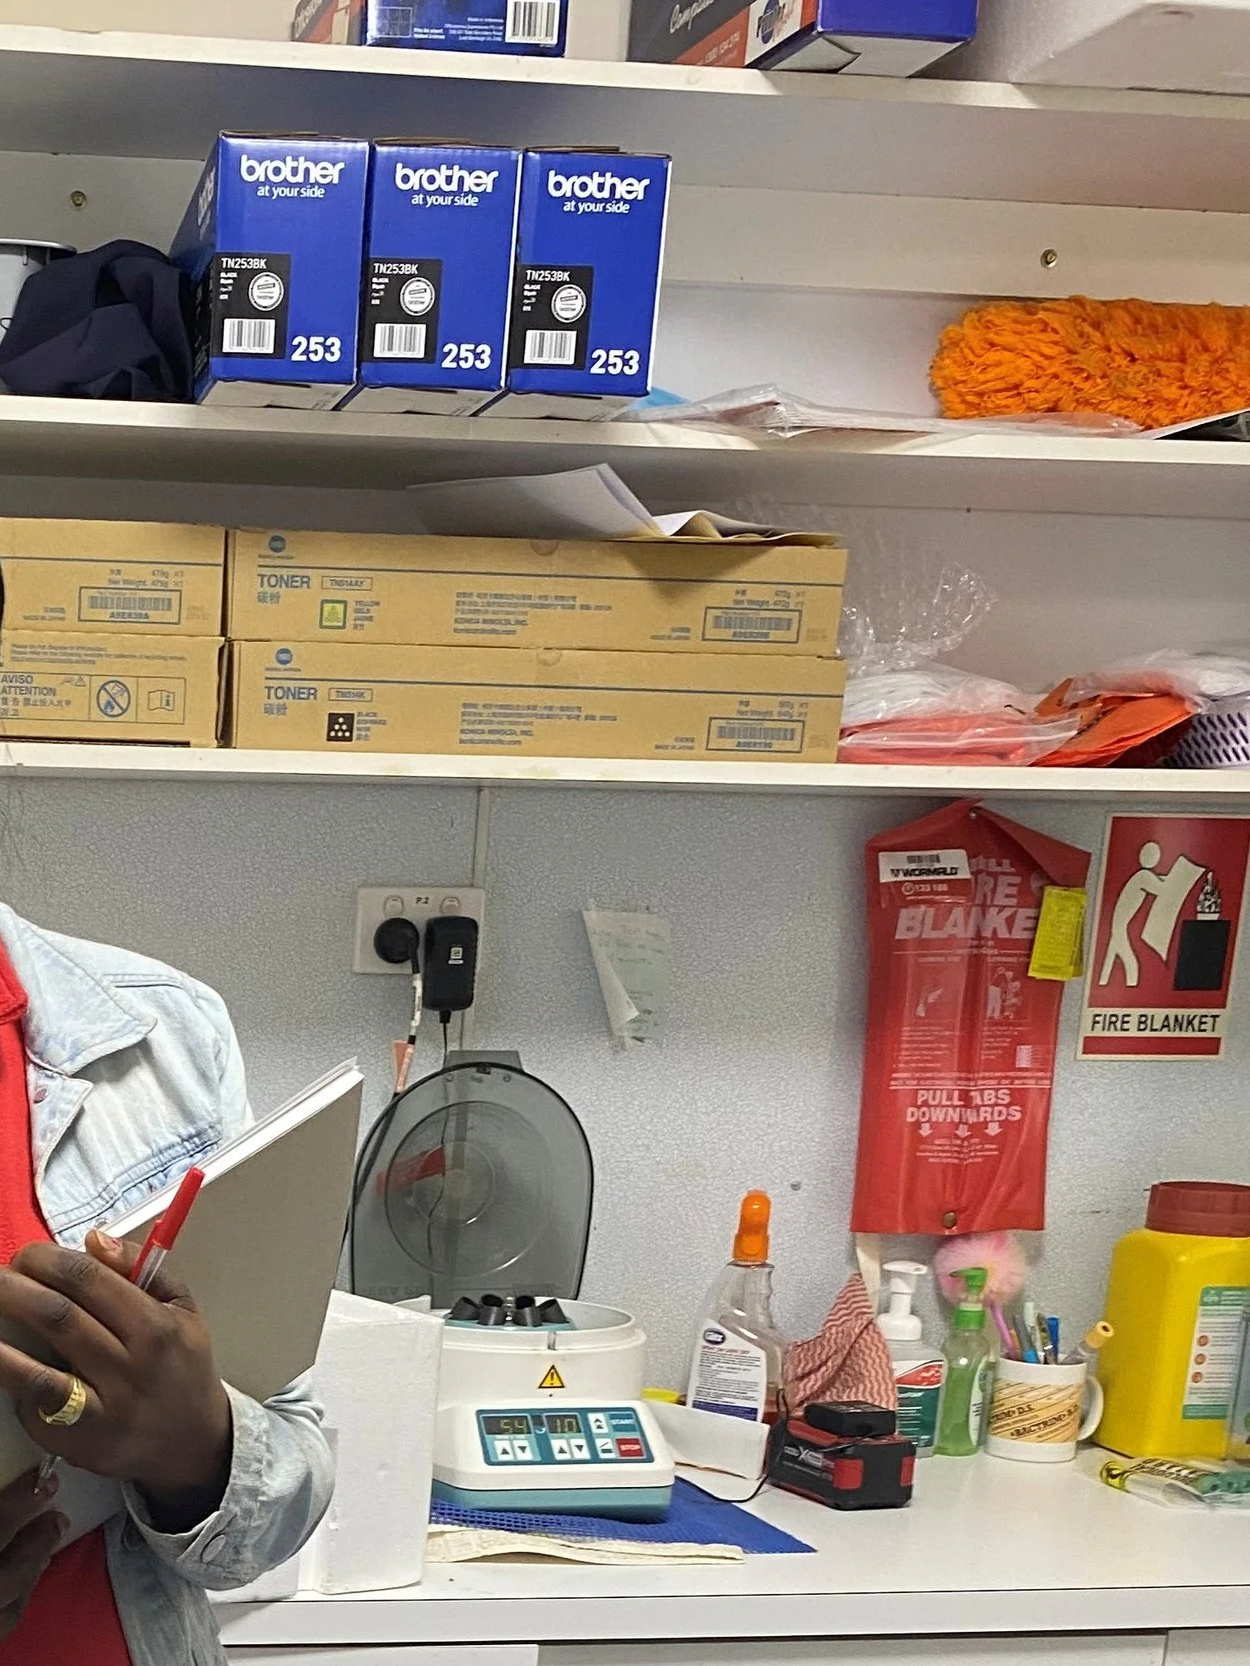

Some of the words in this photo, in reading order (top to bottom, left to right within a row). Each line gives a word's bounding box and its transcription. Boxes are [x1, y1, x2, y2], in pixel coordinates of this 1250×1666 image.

[240, 154, 345, 184] brother
[395, 162, 499, 193] brother
[547, 170, 650, 200] brother
[257, 185, 270, 197] at
[272, 186, 300, 199] your
[300, 185, 325, 198] side
[411, 194, 424, 205] at
[426, 195, 453, 208] your
[453, 193, 479, 206] side
[563, 200, 575, 212] at
[577, 202, 605, 214] your
[605, 200, 630, 213] side
[221, 257, 267, 269] TN253BK
[373, 263, 418, 274] TN253BK
[525, 269, 570, 281] TN253BK
[291, 336, 341, 362] 253
[441, 343, 491, 369] 253
[590, 349, 640, 375] 253
[257, 574, 311, 588] TONER
[1, 674, 33, 684] AVISO
[1, 686, 56, 697] ATTENTION
[264, 686, 318, 700] TONER
[903, 867, 959, 877] WORMALD
[975, 872, 1022, 906] RE
[895, 904, 1039, 939] BLANKE
[1091, 1014, 1131, 1031] FIRE
[1137, 1014, 1220, 1032] BLANKET
[917, 1089, 964, 1106] PULL
[501, 1419, 527, 1434] 54
[556, 1418, 577, 1433] 10
